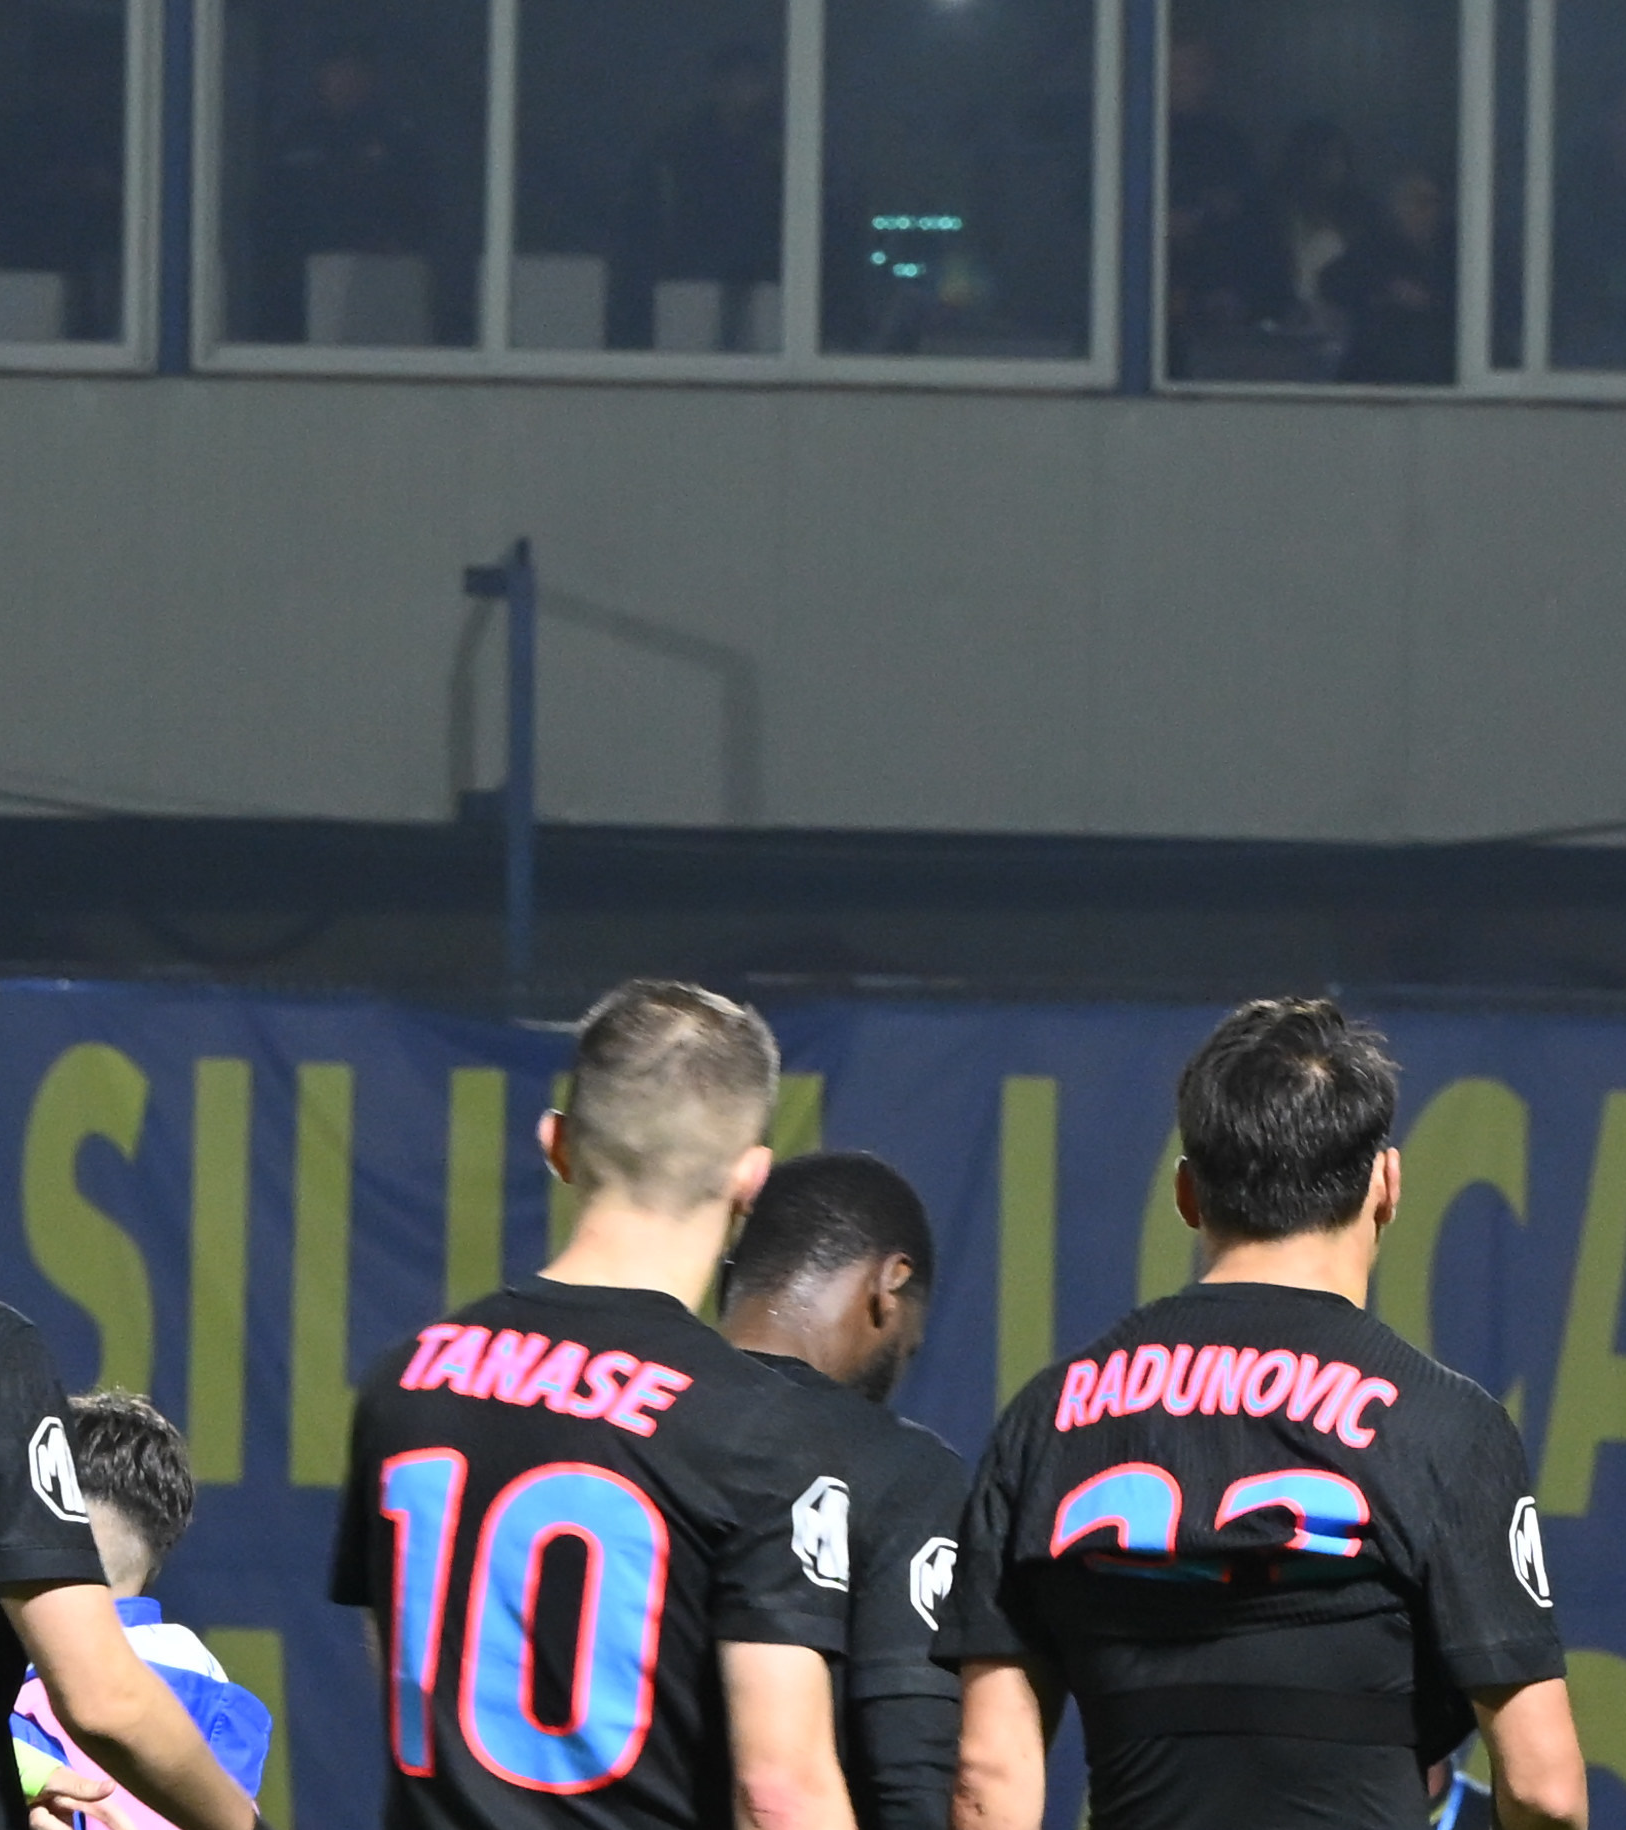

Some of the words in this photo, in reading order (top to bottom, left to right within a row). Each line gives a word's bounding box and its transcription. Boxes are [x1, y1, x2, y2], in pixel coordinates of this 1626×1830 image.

[399, 1322, 694, 1438] TANASE
[1054, 1343, 1399, 1449] RADUNOVIC
[381, 1447, 670, 1795] 10
